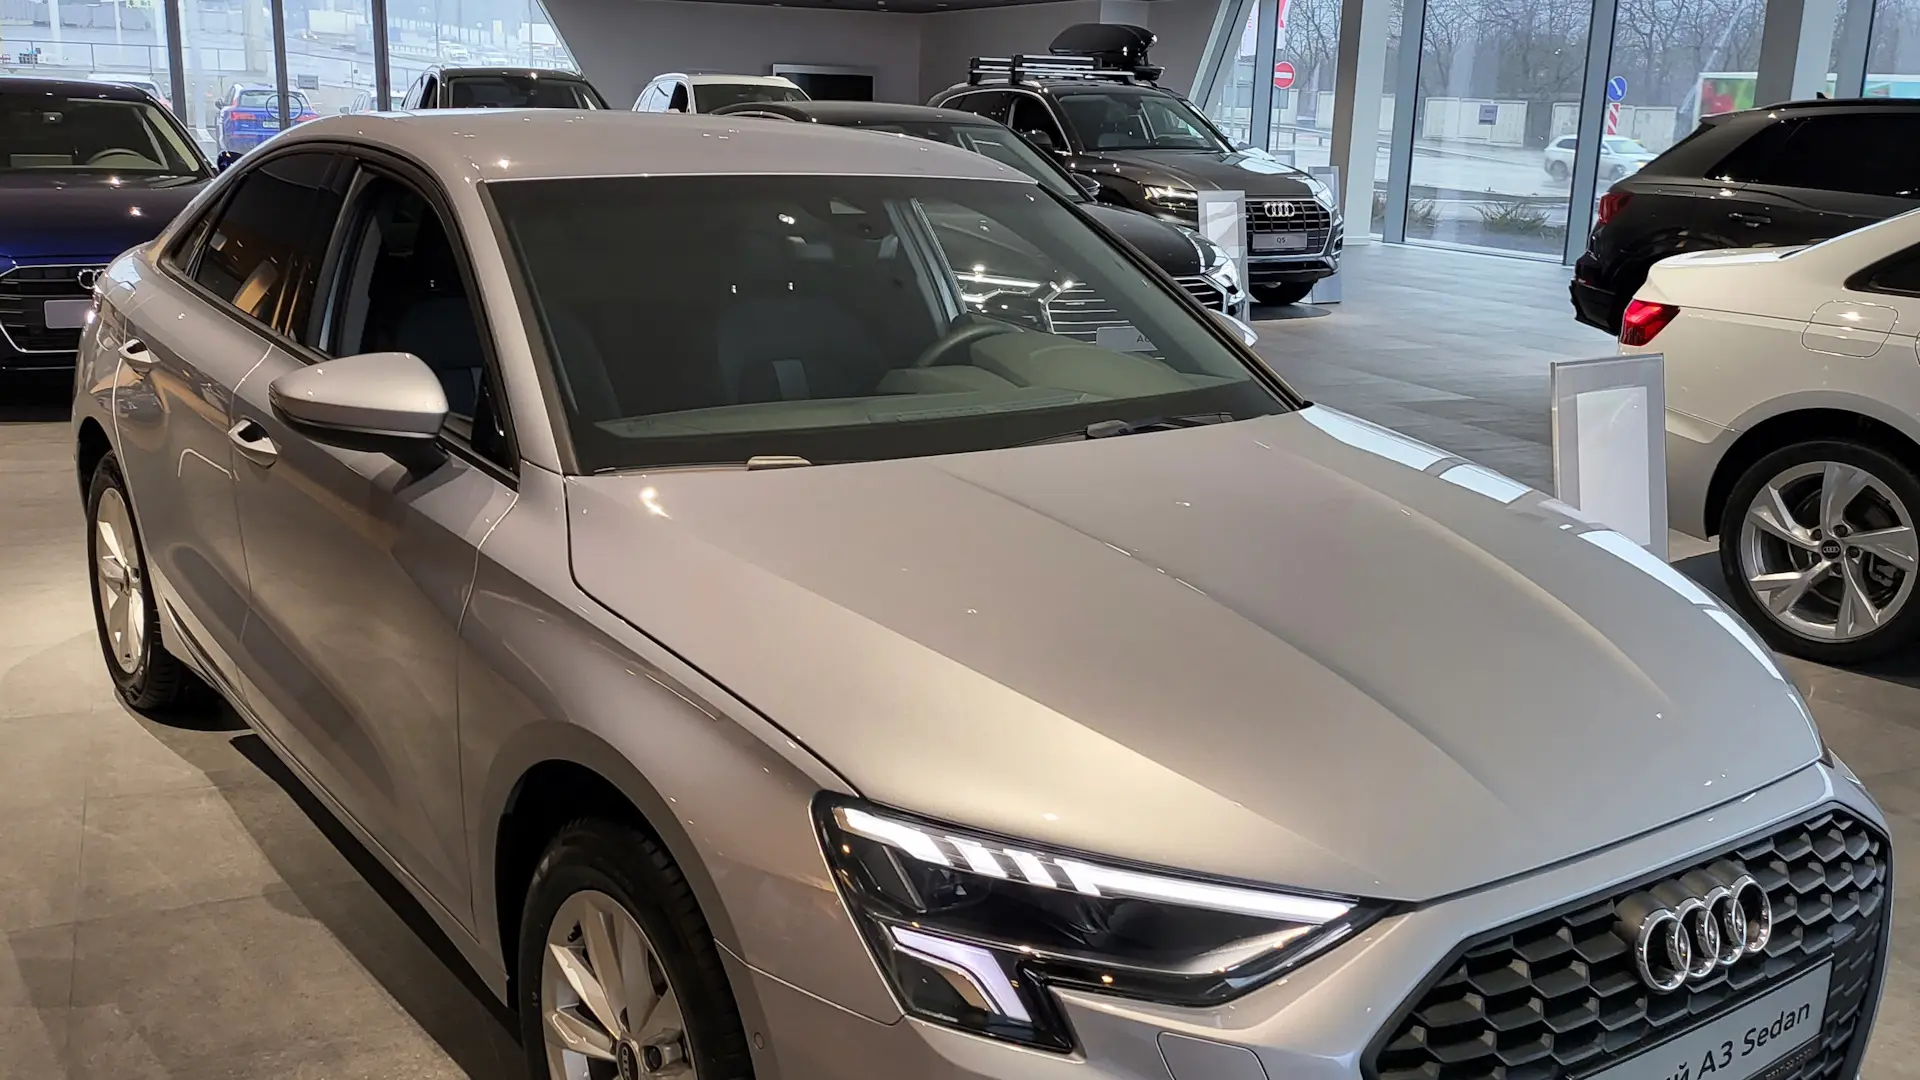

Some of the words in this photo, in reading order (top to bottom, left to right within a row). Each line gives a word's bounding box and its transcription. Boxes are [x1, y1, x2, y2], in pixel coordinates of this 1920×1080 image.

[1276, 236, 1286, 244] Q5
[1697, 1041, 1734, 1080] A3
[1741, 1003, 1810, 1056] Sedan
